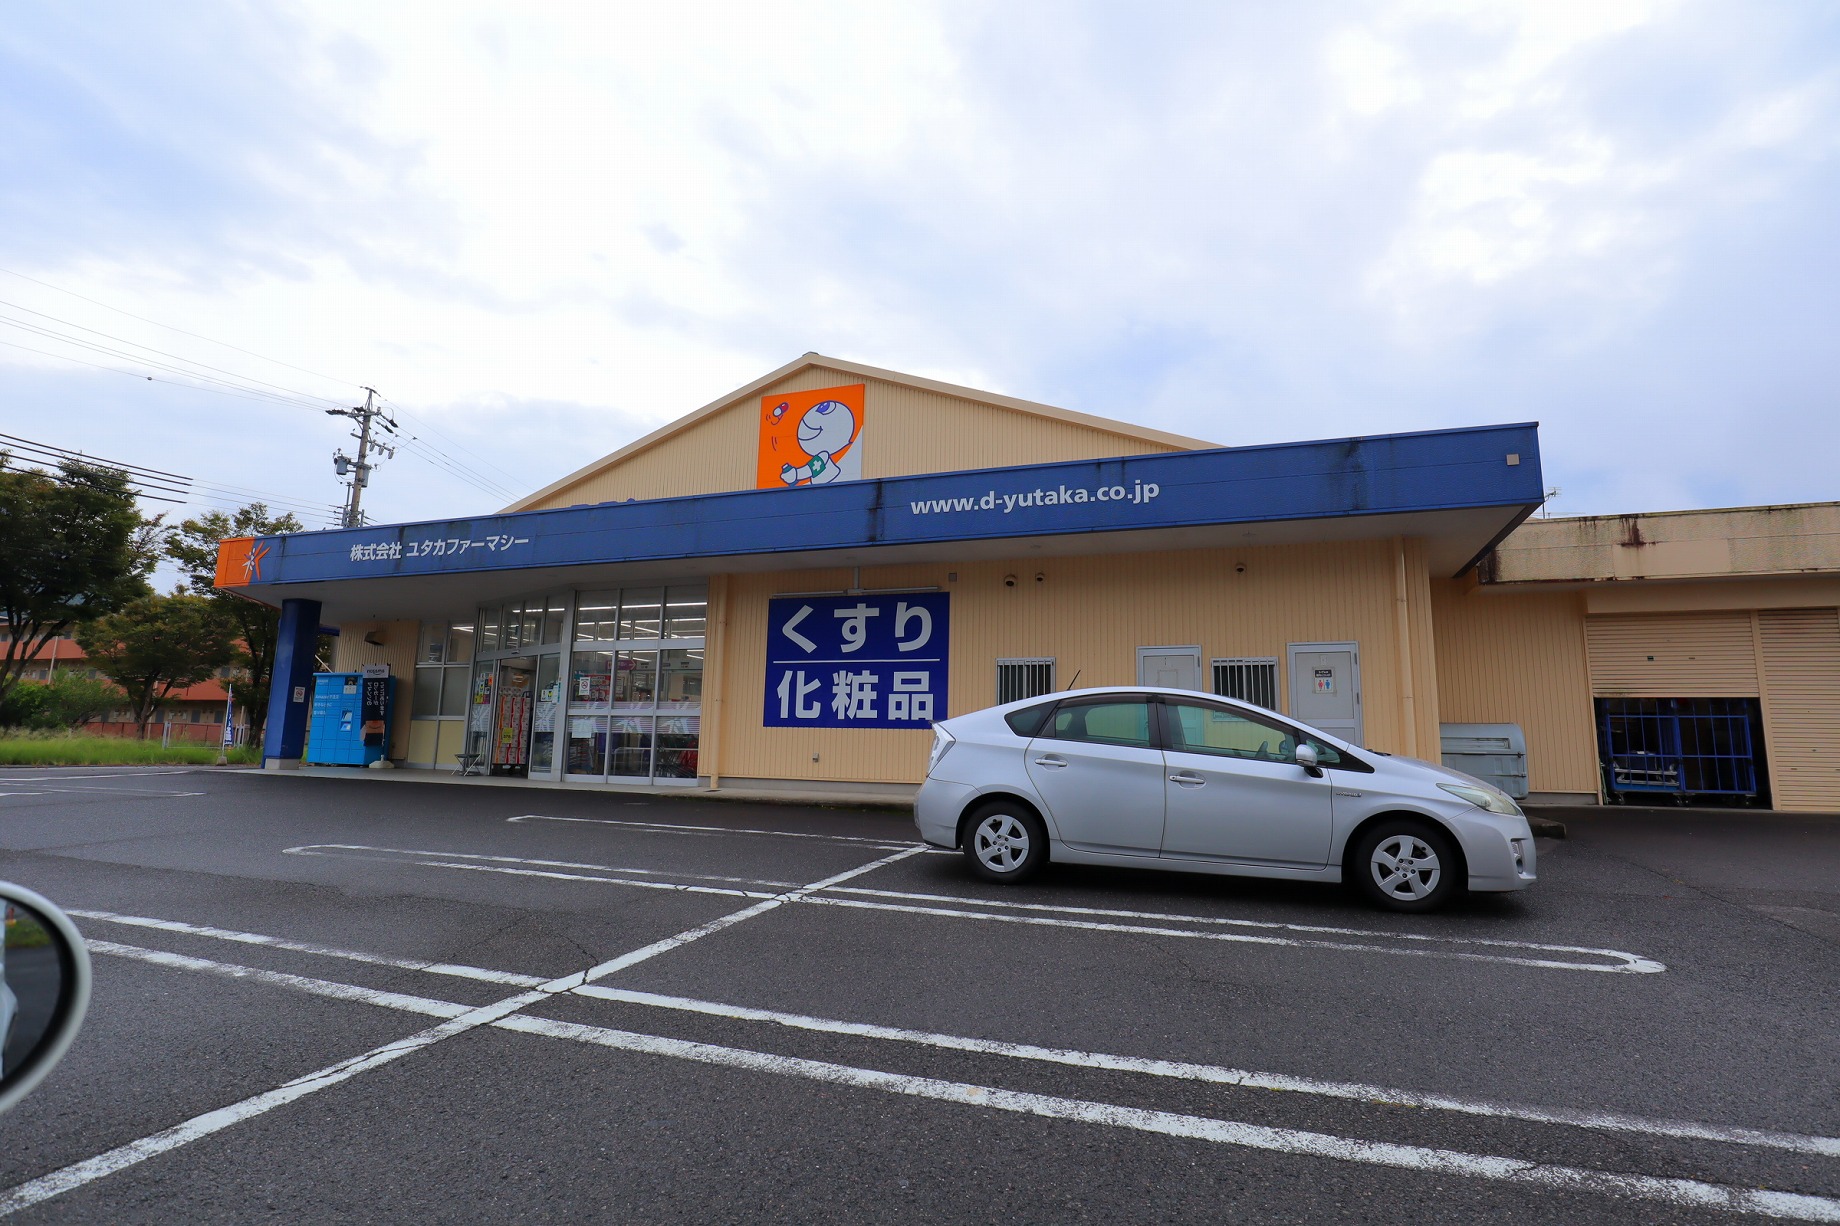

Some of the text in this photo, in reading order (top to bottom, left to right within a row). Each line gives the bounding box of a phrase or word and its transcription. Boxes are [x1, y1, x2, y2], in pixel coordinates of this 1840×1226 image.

[910, 479, 1160, 515] www.d-yutaka.co.jp
[350, 534, 529, 562] 株式会社 ユタカファーマシー
[782, 602, 932, 654] くすり
[777, 670, 934, 720] 化粧品
